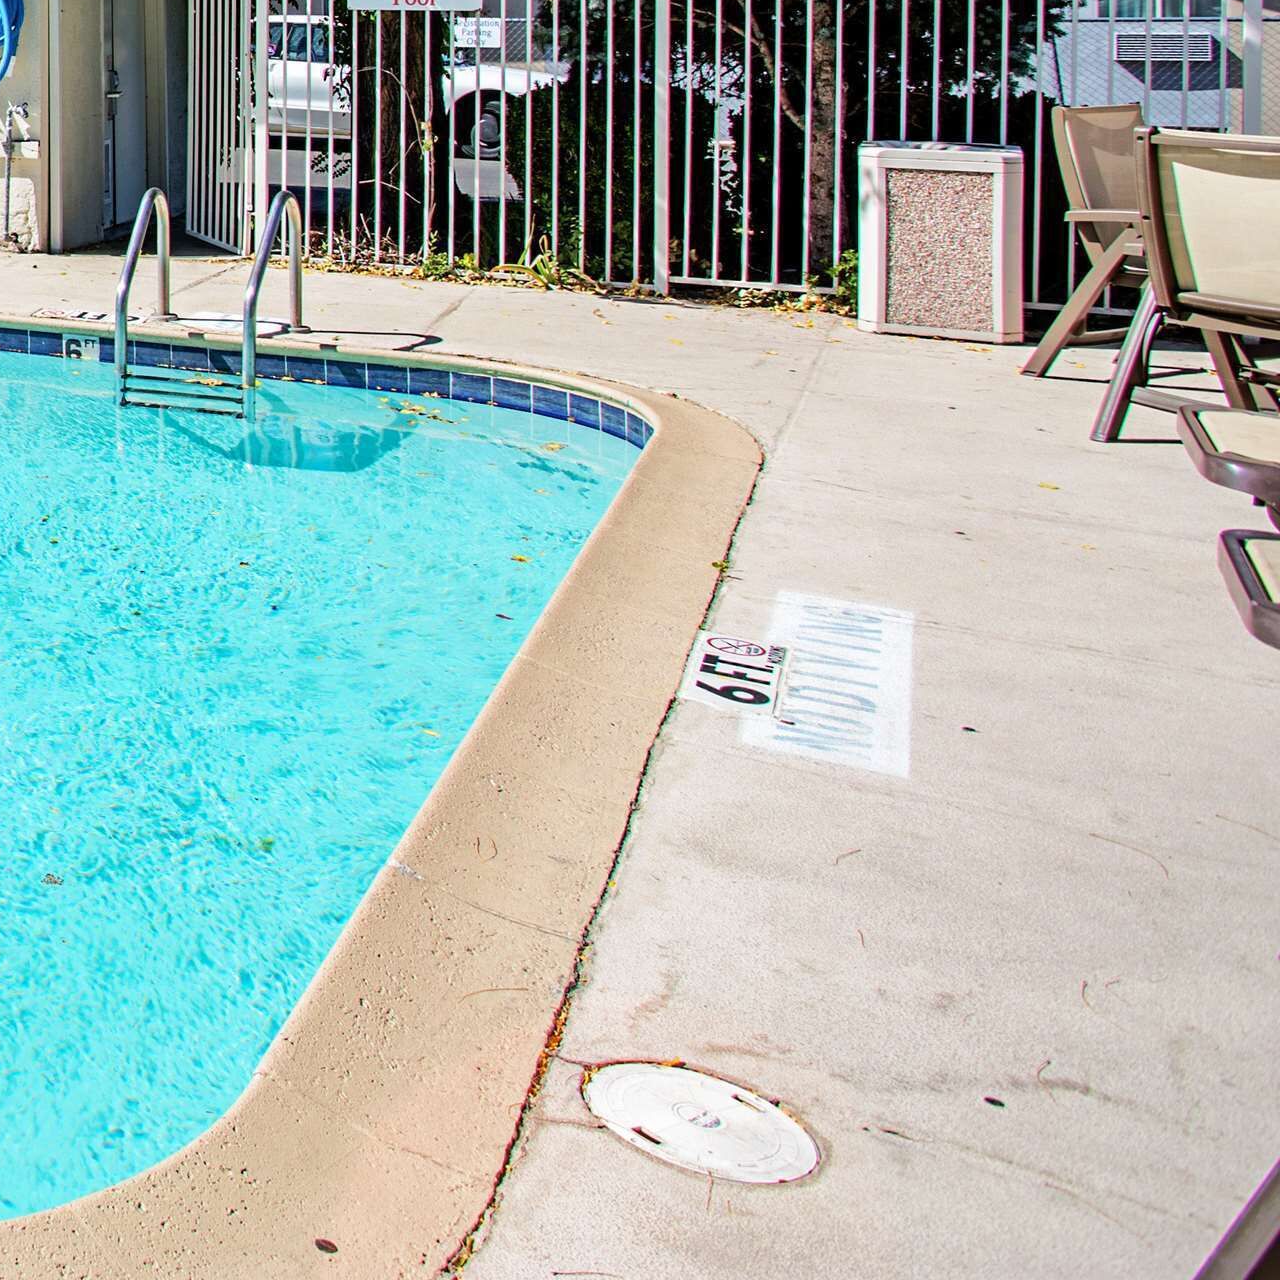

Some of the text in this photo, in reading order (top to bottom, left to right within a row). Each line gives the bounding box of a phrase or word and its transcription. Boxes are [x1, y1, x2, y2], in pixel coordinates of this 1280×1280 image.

[65, 338, 97, 359] 6 FT
[695, 680, 771, 705] 6
